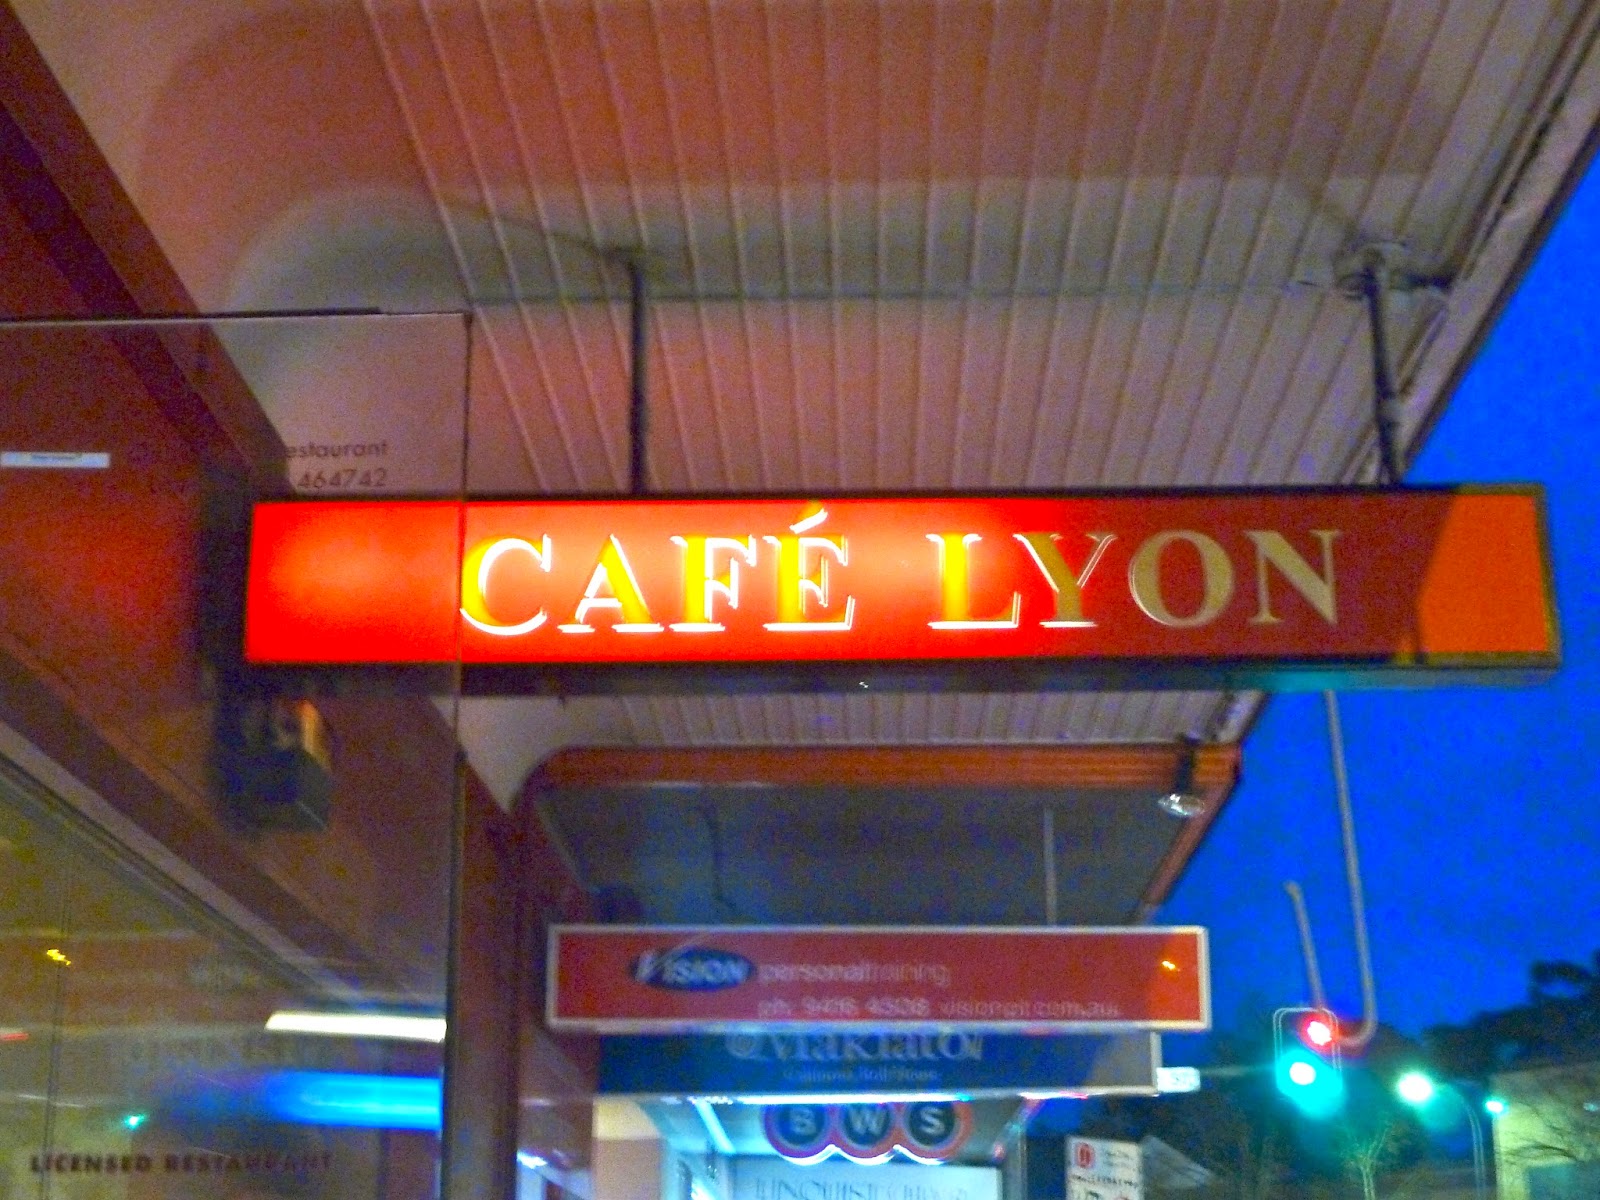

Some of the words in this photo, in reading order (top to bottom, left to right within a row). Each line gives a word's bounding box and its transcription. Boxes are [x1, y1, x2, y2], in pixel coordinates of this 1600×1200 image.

[285, 440, 387, 458] estaurant
[298, 467, 387, 488] 464742
[460, 502, 855, 636] CAFÉ
[925, 529, 1340, 628] LYON
[29, 1154, 153, 1173] LICENSED
[164, 1152, 333, 1173] RESTAURANT
